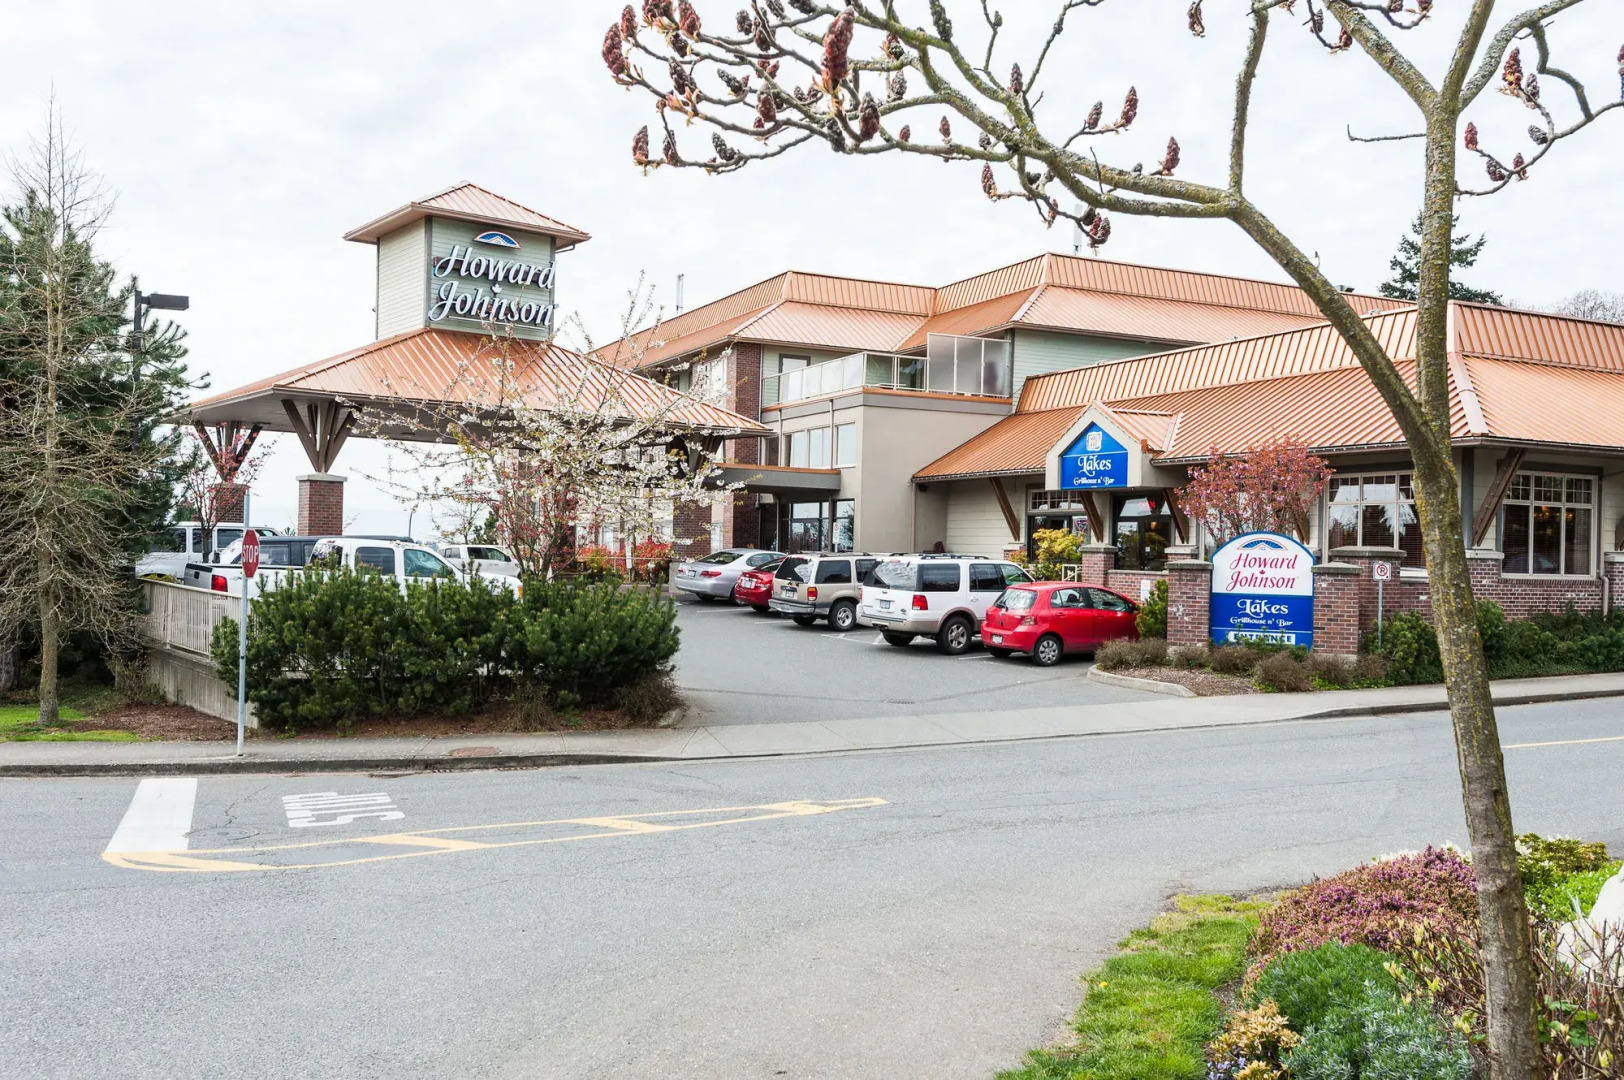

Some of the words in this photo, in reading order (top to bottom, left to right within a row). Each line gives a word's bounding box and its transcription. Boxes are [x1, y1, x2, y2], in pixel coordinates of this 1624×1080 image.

[433, 245, 556, 289] Howard
[428, 281, 555, 326] Johnson
[1078, 455, 1111, 476] Lakes
[242, 544, 259, 563] STOP
[1230, 553, 1297, 569] Howard
[1226, 571, 1295, 591] Johnson
[1237, 599, 1288, 618] Lakes
[1230, 616, 1266, 625] Grillhouse
[1276, 619, 1294, 627] Bar
